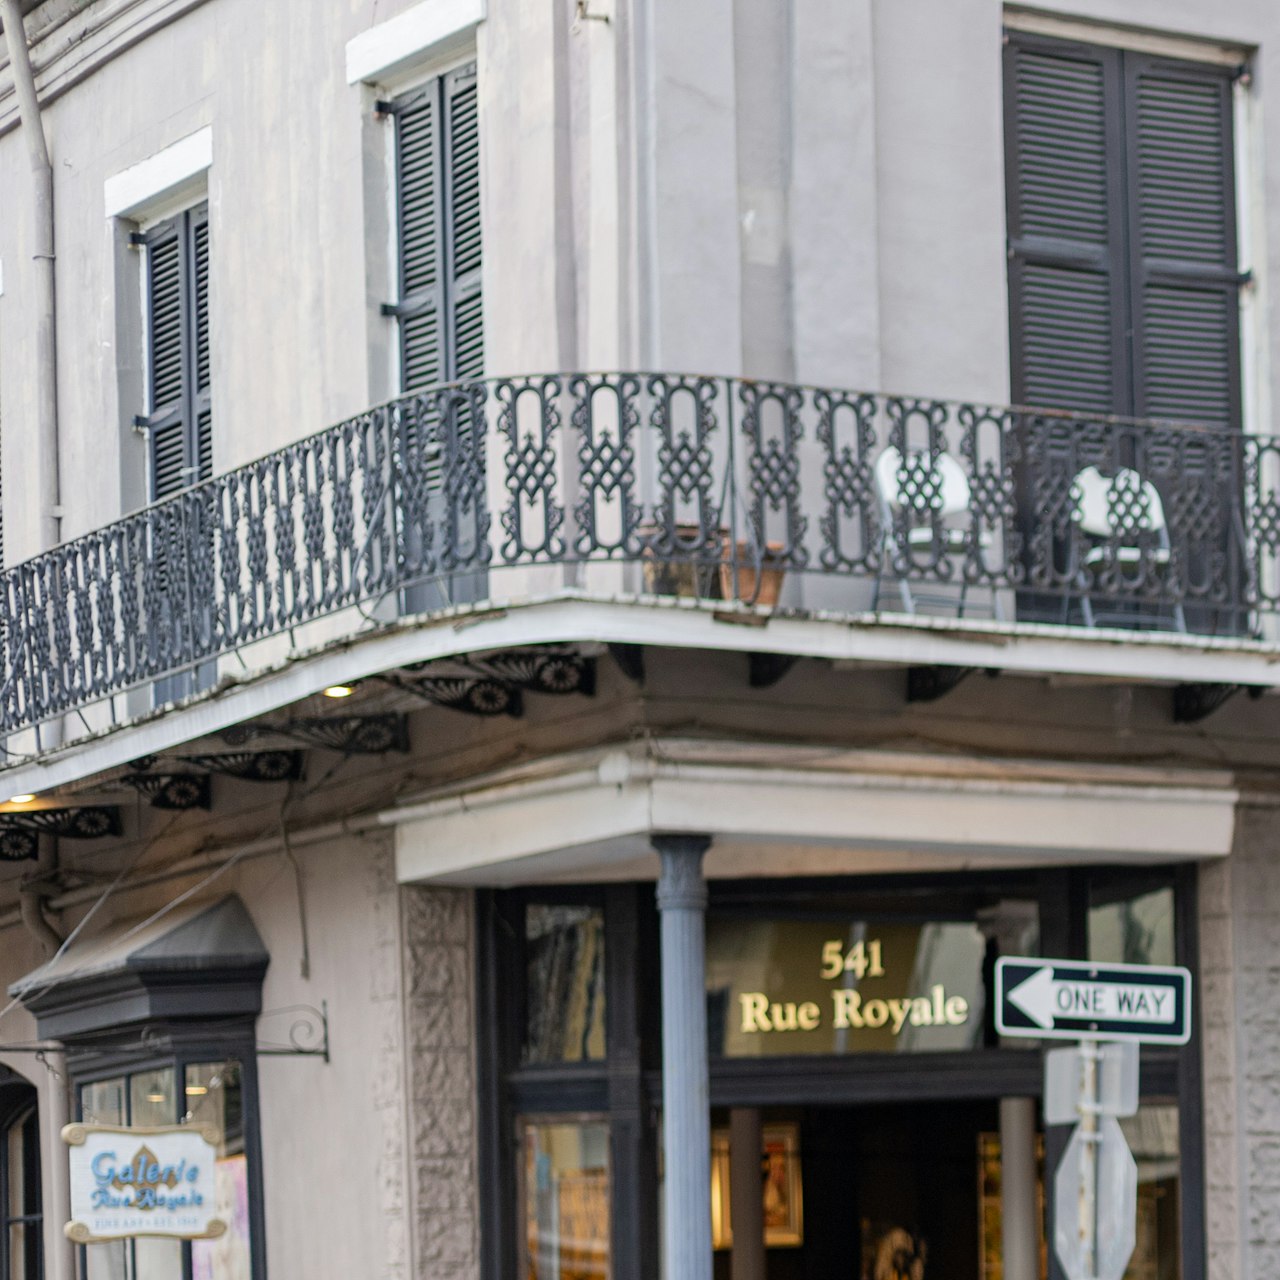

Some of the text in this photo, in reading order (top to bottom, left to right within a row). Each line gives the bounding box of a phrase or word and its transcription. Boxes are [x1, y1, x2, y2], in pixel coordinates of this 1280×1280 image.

[820, 938, 885, 980] 541
[739, 983, 969, 1035] Rue Royale
[1057, 985, 1166, 1016] ONE WAY
[91, 1151, 199, 1187] Galerie
